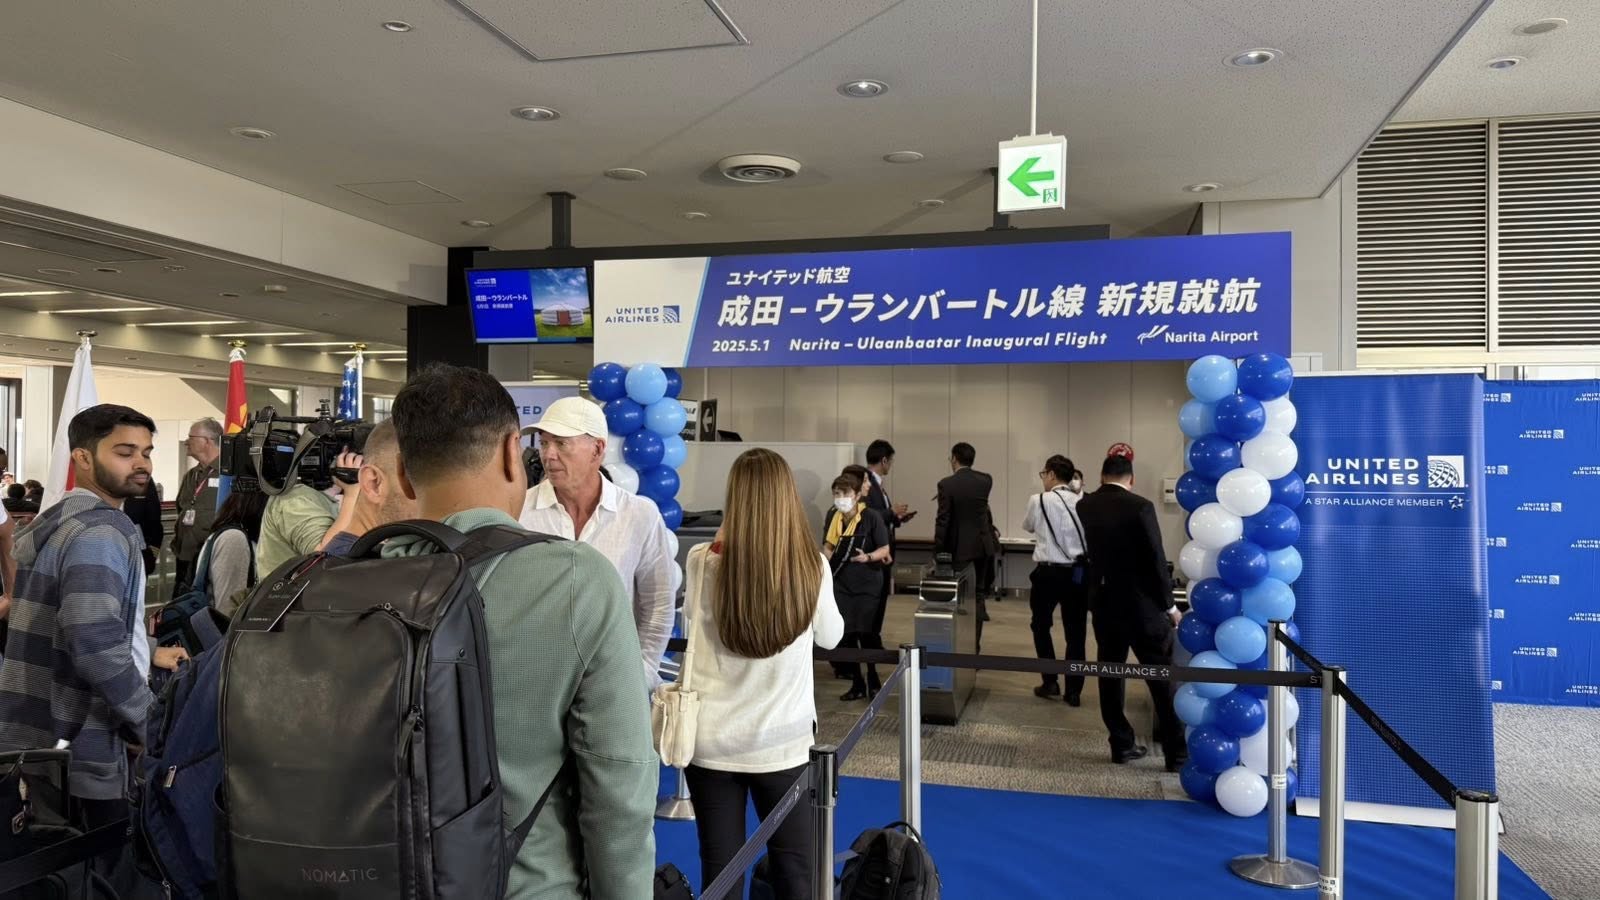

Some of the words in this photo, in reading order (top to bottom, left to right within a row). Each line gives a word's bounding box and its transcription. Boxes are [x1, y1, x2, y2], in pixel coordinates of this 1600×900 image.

[726, 266, 851, 286] ユナイテッド航空
[1096, 277, 1261, 318] 新規就航
[616, 307, 659, 316] UNITED
[605, 315, 659, 324] AIRLINES
[789, 338, 840, 351] Narita
[857, 336, 961, 350] Ulaanbaatar
[966, 332, 1050, 350] Inaugural
[1054, 331, 1107, 349] Flight
[1165, 331, 1206, 343] Narita
[1210, 330, 1259, 344] Airport
[712, 339, 770, 353] 2025.5.1
[1327, 458, 1419, 470] UNITED
[1305, 473, 1420, 485] AIRLINES
[1315, 498, 1340, 506] STAR
[1343, 498, 1394, 506] ALLIANCE
[1396, 499, 1444, 507] MEMBER
[1070, 664, 1098, 672] STAR
[1101, 664, 1157, 676] ALLIANCE
